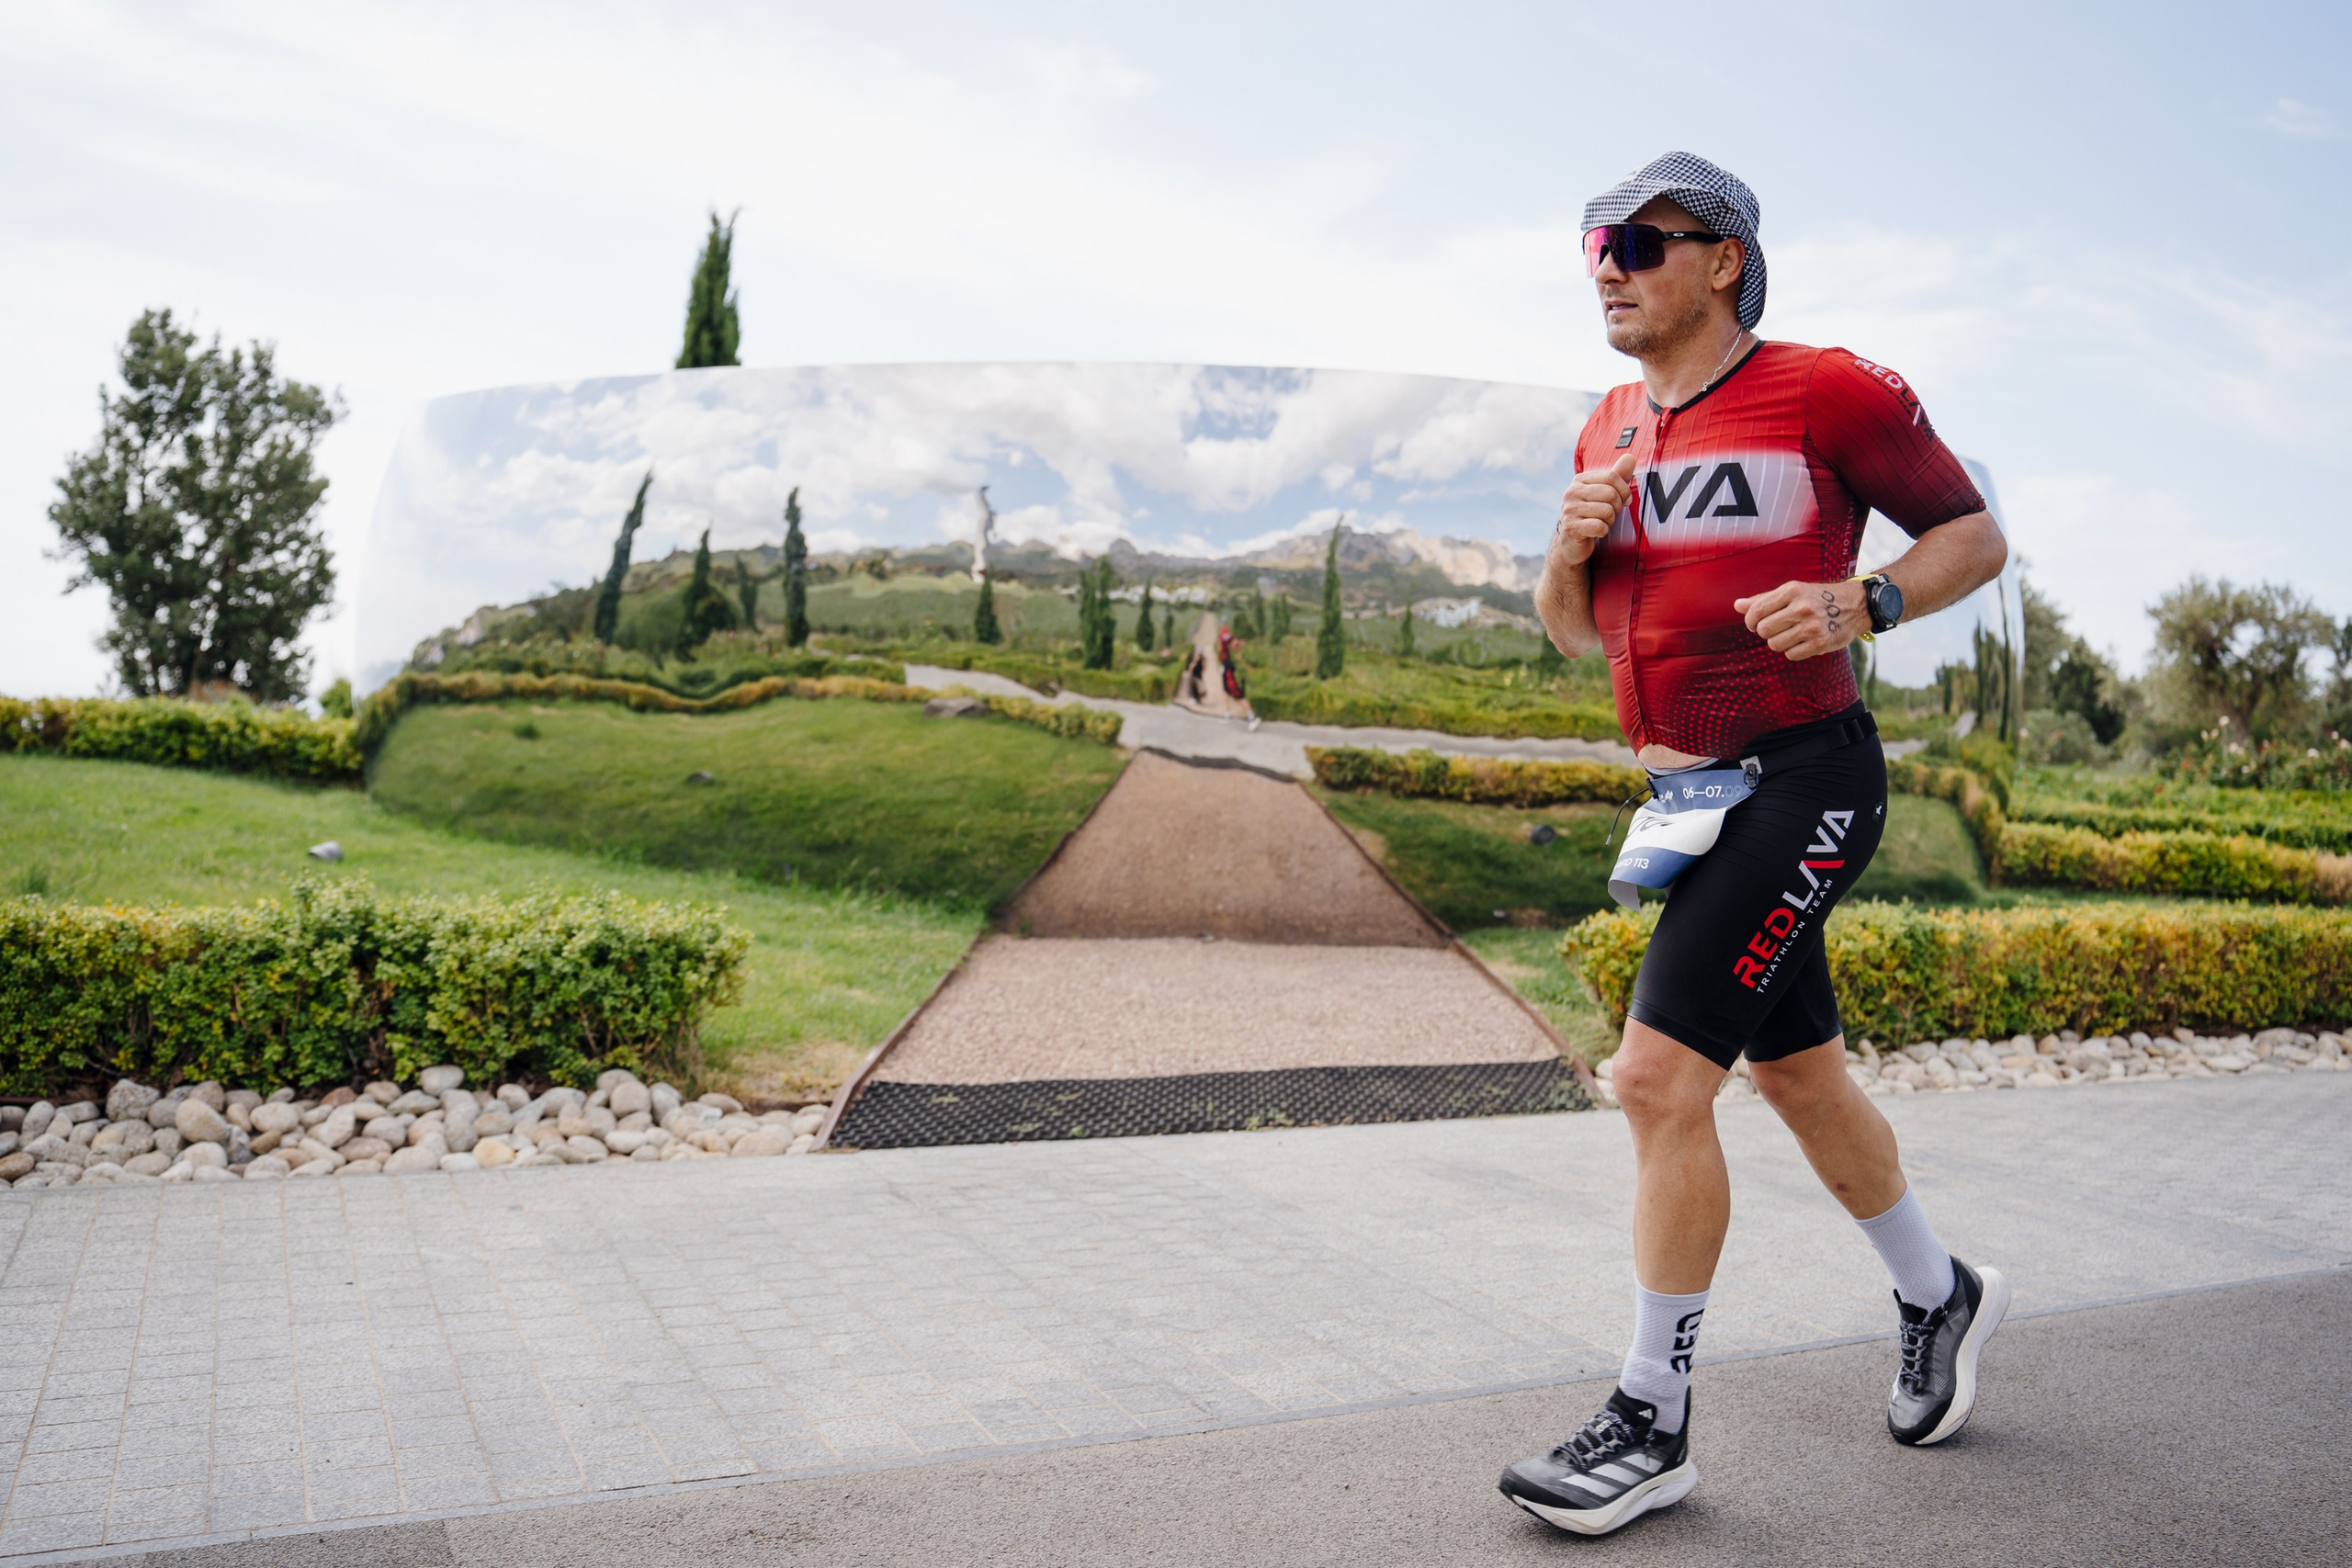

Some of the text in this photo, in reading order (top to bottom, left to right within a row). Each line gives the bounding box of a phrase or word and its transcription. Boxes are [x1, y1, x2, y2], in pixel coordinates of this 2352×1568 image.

[1634, 856, 1650, 870] 113
[1757, 878, 1833, 994] TRIATHLON TEAM
